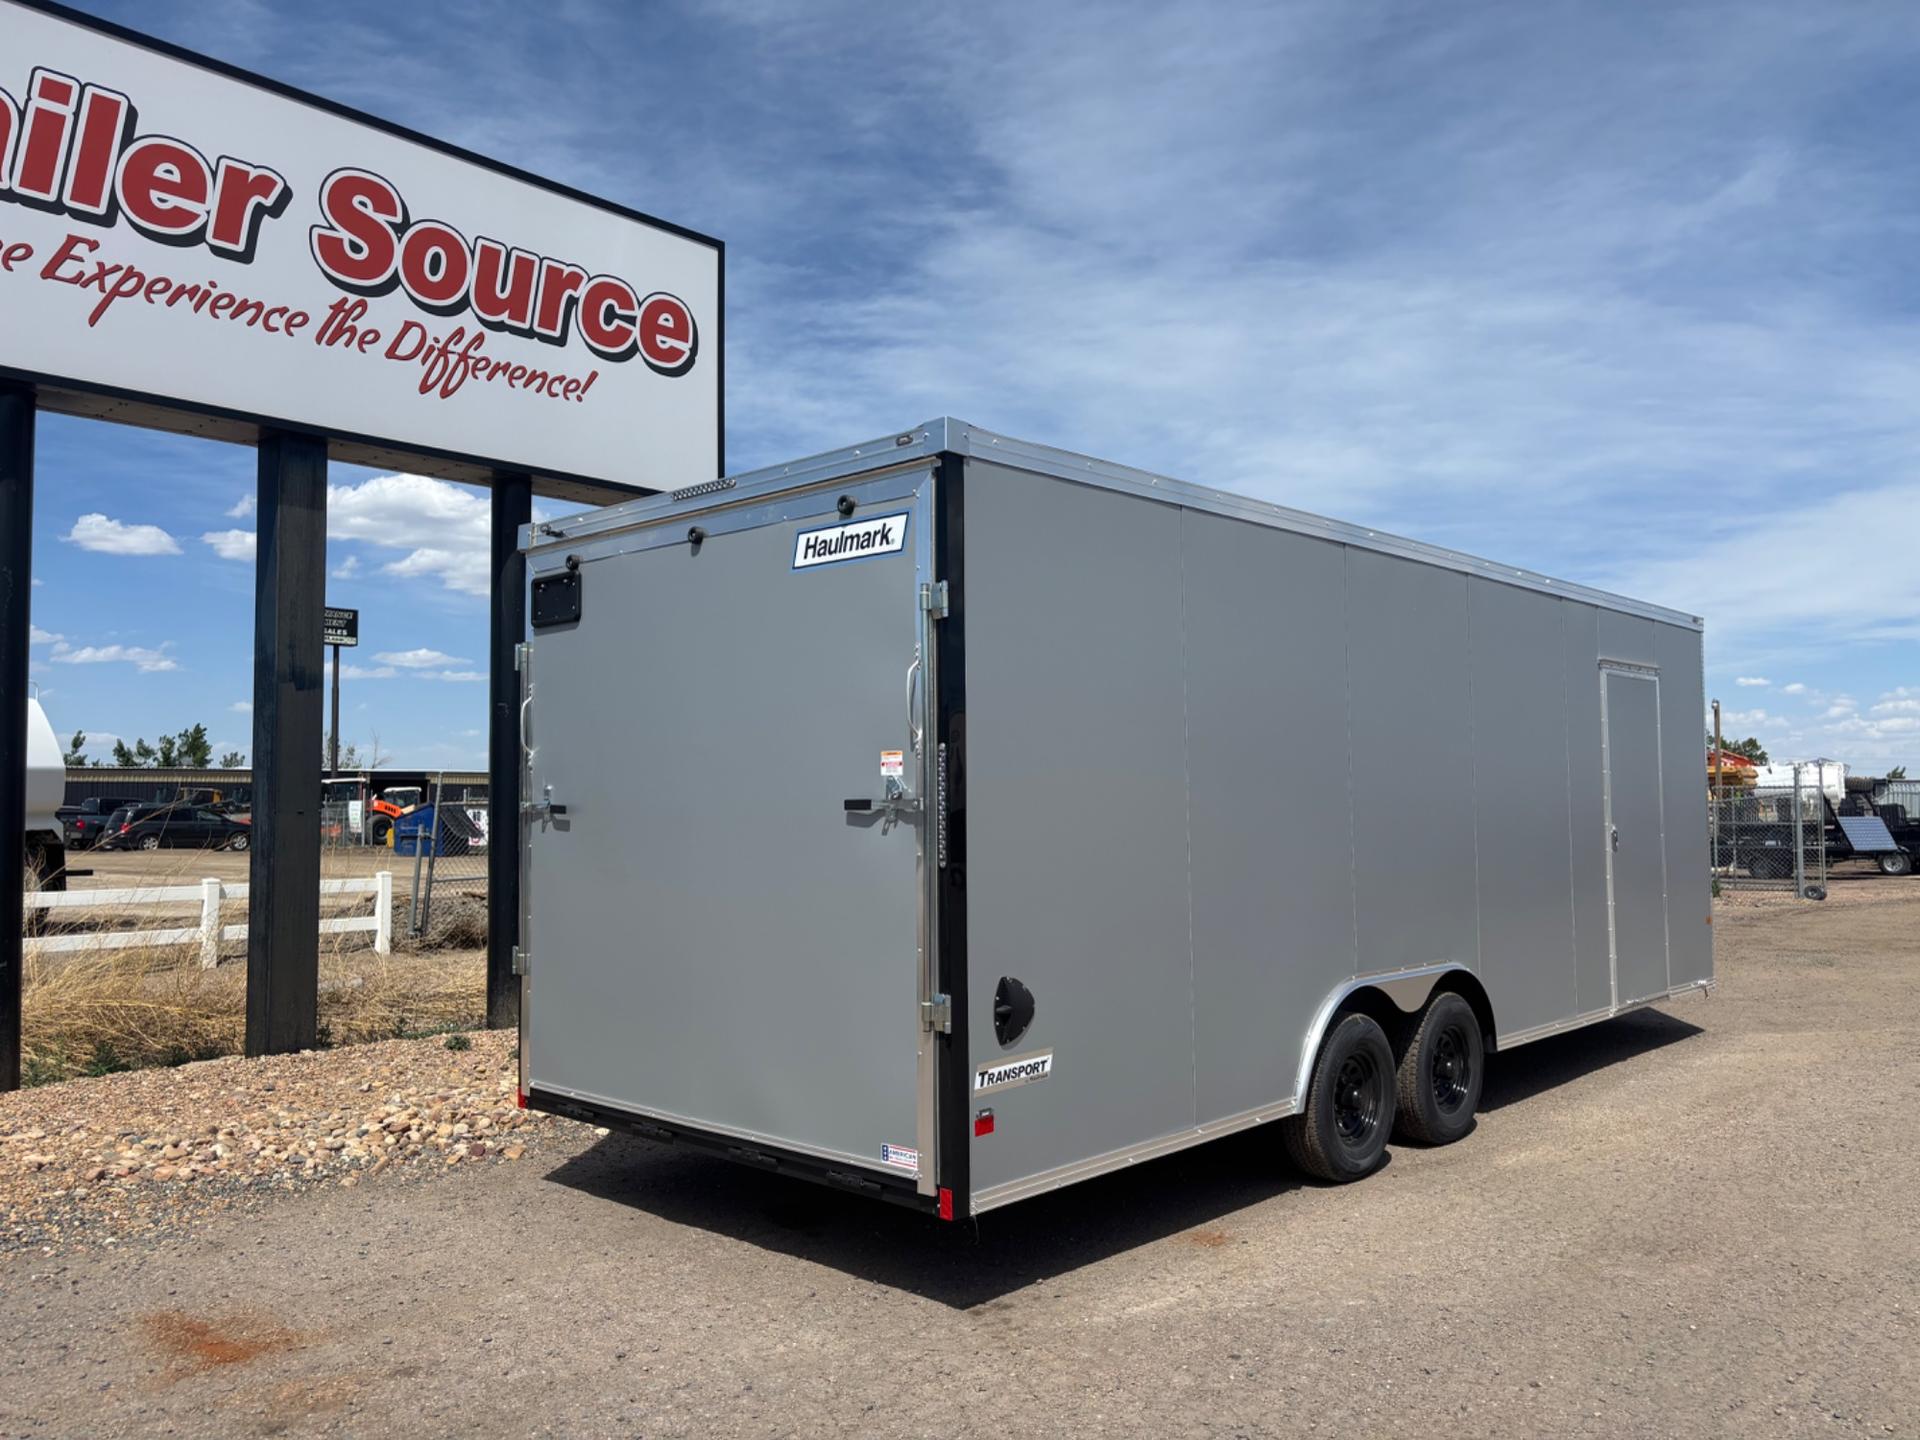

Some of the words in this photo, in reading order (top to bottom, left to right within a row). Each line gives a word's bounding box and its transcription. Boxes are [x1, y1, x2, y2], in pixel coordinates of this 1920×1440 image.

[0, 66, 293, 264] iler
[309, 167, 699, 378] Source
[0, 239, 34, 272] e
[40, 233, 310, 337] Experience
[315, 296, 381, 354] the
[384, 320, 599, 402] Difference!
[803, 522, 893, 560] Haulmark
